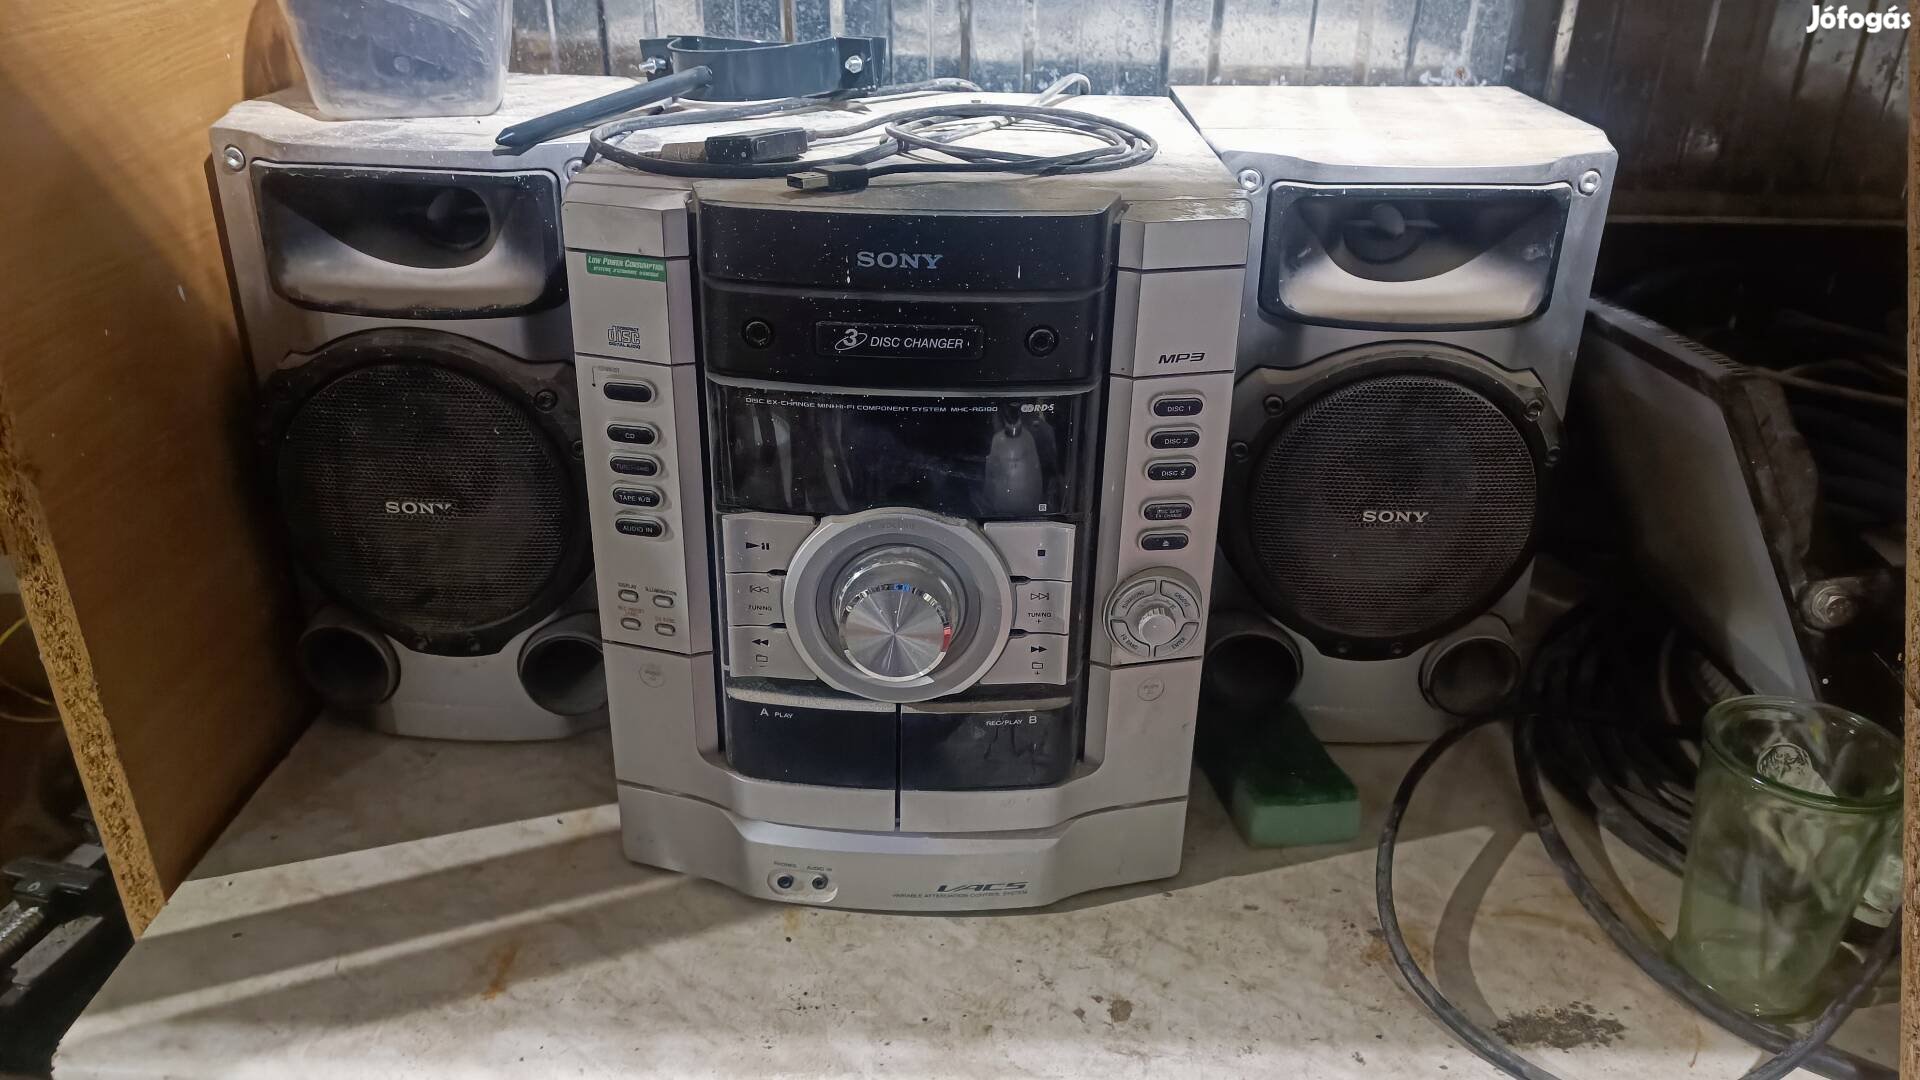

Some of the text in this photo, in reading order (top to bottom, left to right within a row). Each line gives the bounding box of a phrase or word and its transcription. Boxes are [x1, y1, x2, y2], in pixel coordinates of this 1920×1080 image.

[856, 251, 944, 270] SONY
[843, 328, 964, 349] 3 DISC CHANGER
[1158, 352, 1206, 364] MP3
[767, 399, 816, 408] EX-CHANGE
[1167, 405, 1185, 413] DISC
[619, 494, 636, 502] TAPE
[1362, 510, 1429, 523] SONY
[748, 604, 773, 612] TUNING
[760, 707, 794, 719] A PLAY
[1028, 715, 1037, 724] B
